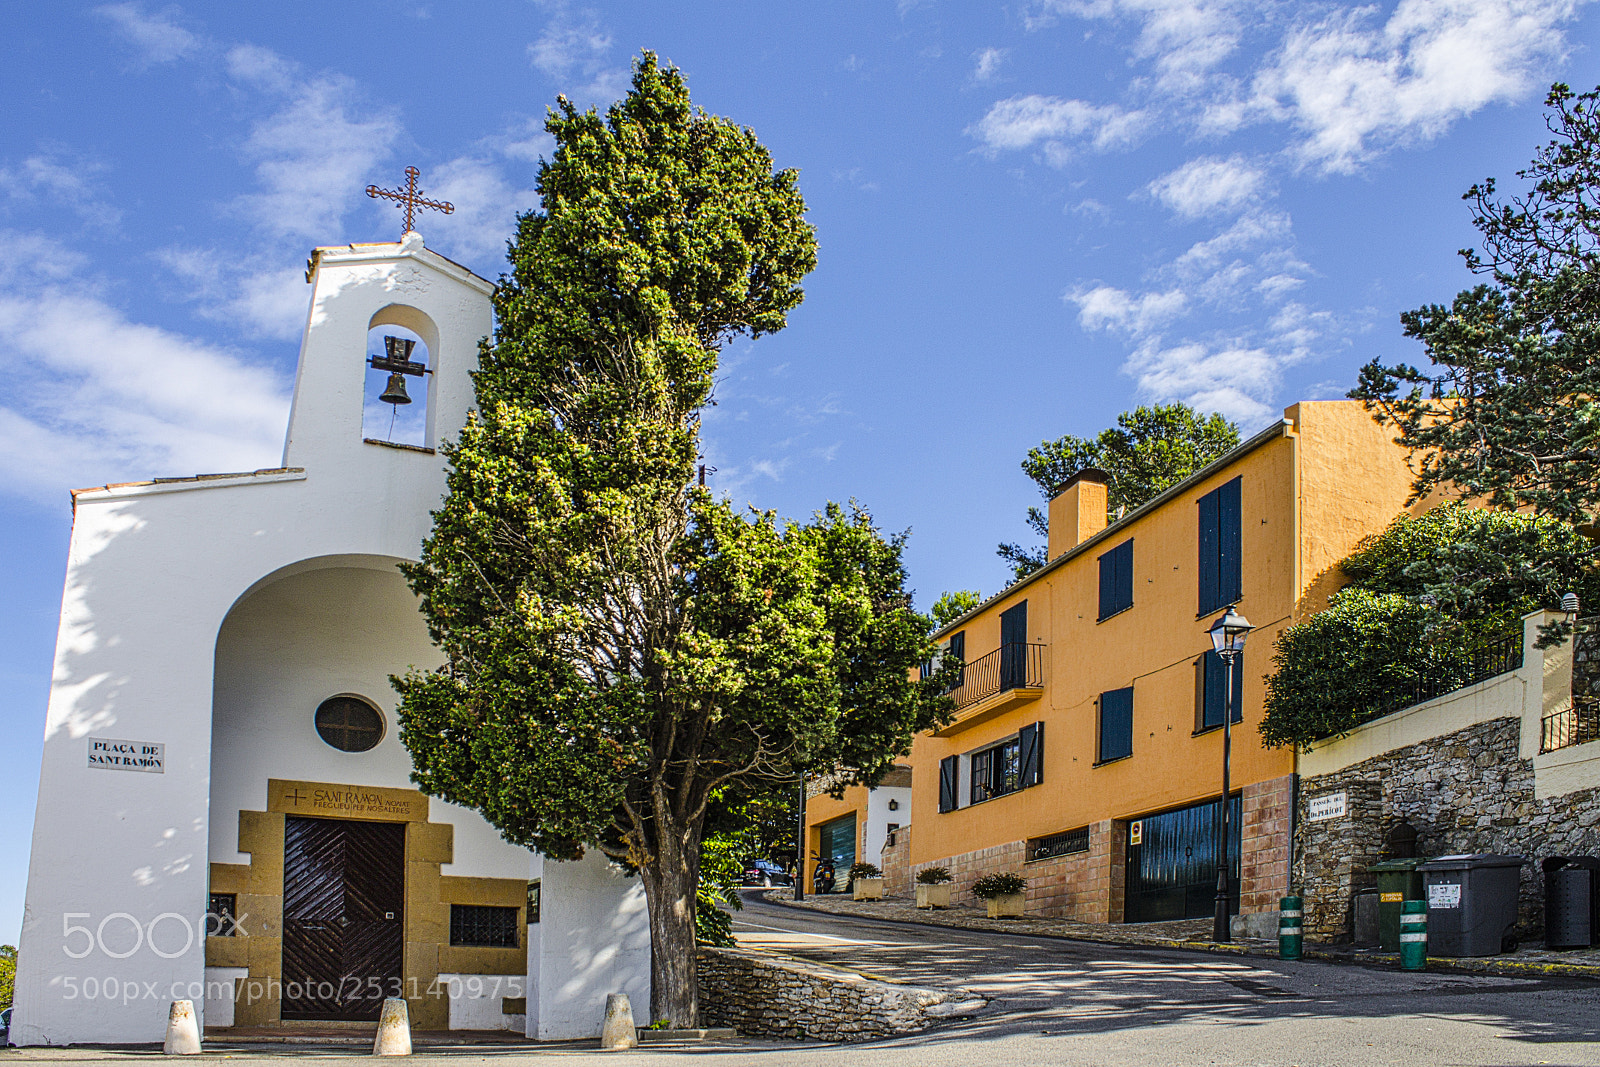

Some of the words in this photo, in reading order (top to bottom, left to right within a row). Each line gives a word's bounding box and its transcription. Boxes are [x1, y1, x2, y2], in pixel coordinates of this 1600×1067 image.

[94, 742, 136, 754] PLAÇA
[142, 746, 159, 755] DE
[89, 754, 121, 765] SANT
[123, 756, 162, 767] RAMÓN
[314, 790, 342, 802] SANT
[345, 792, 383, 805] RAMON
[366, 805, 411, 815] NOSALTRES
